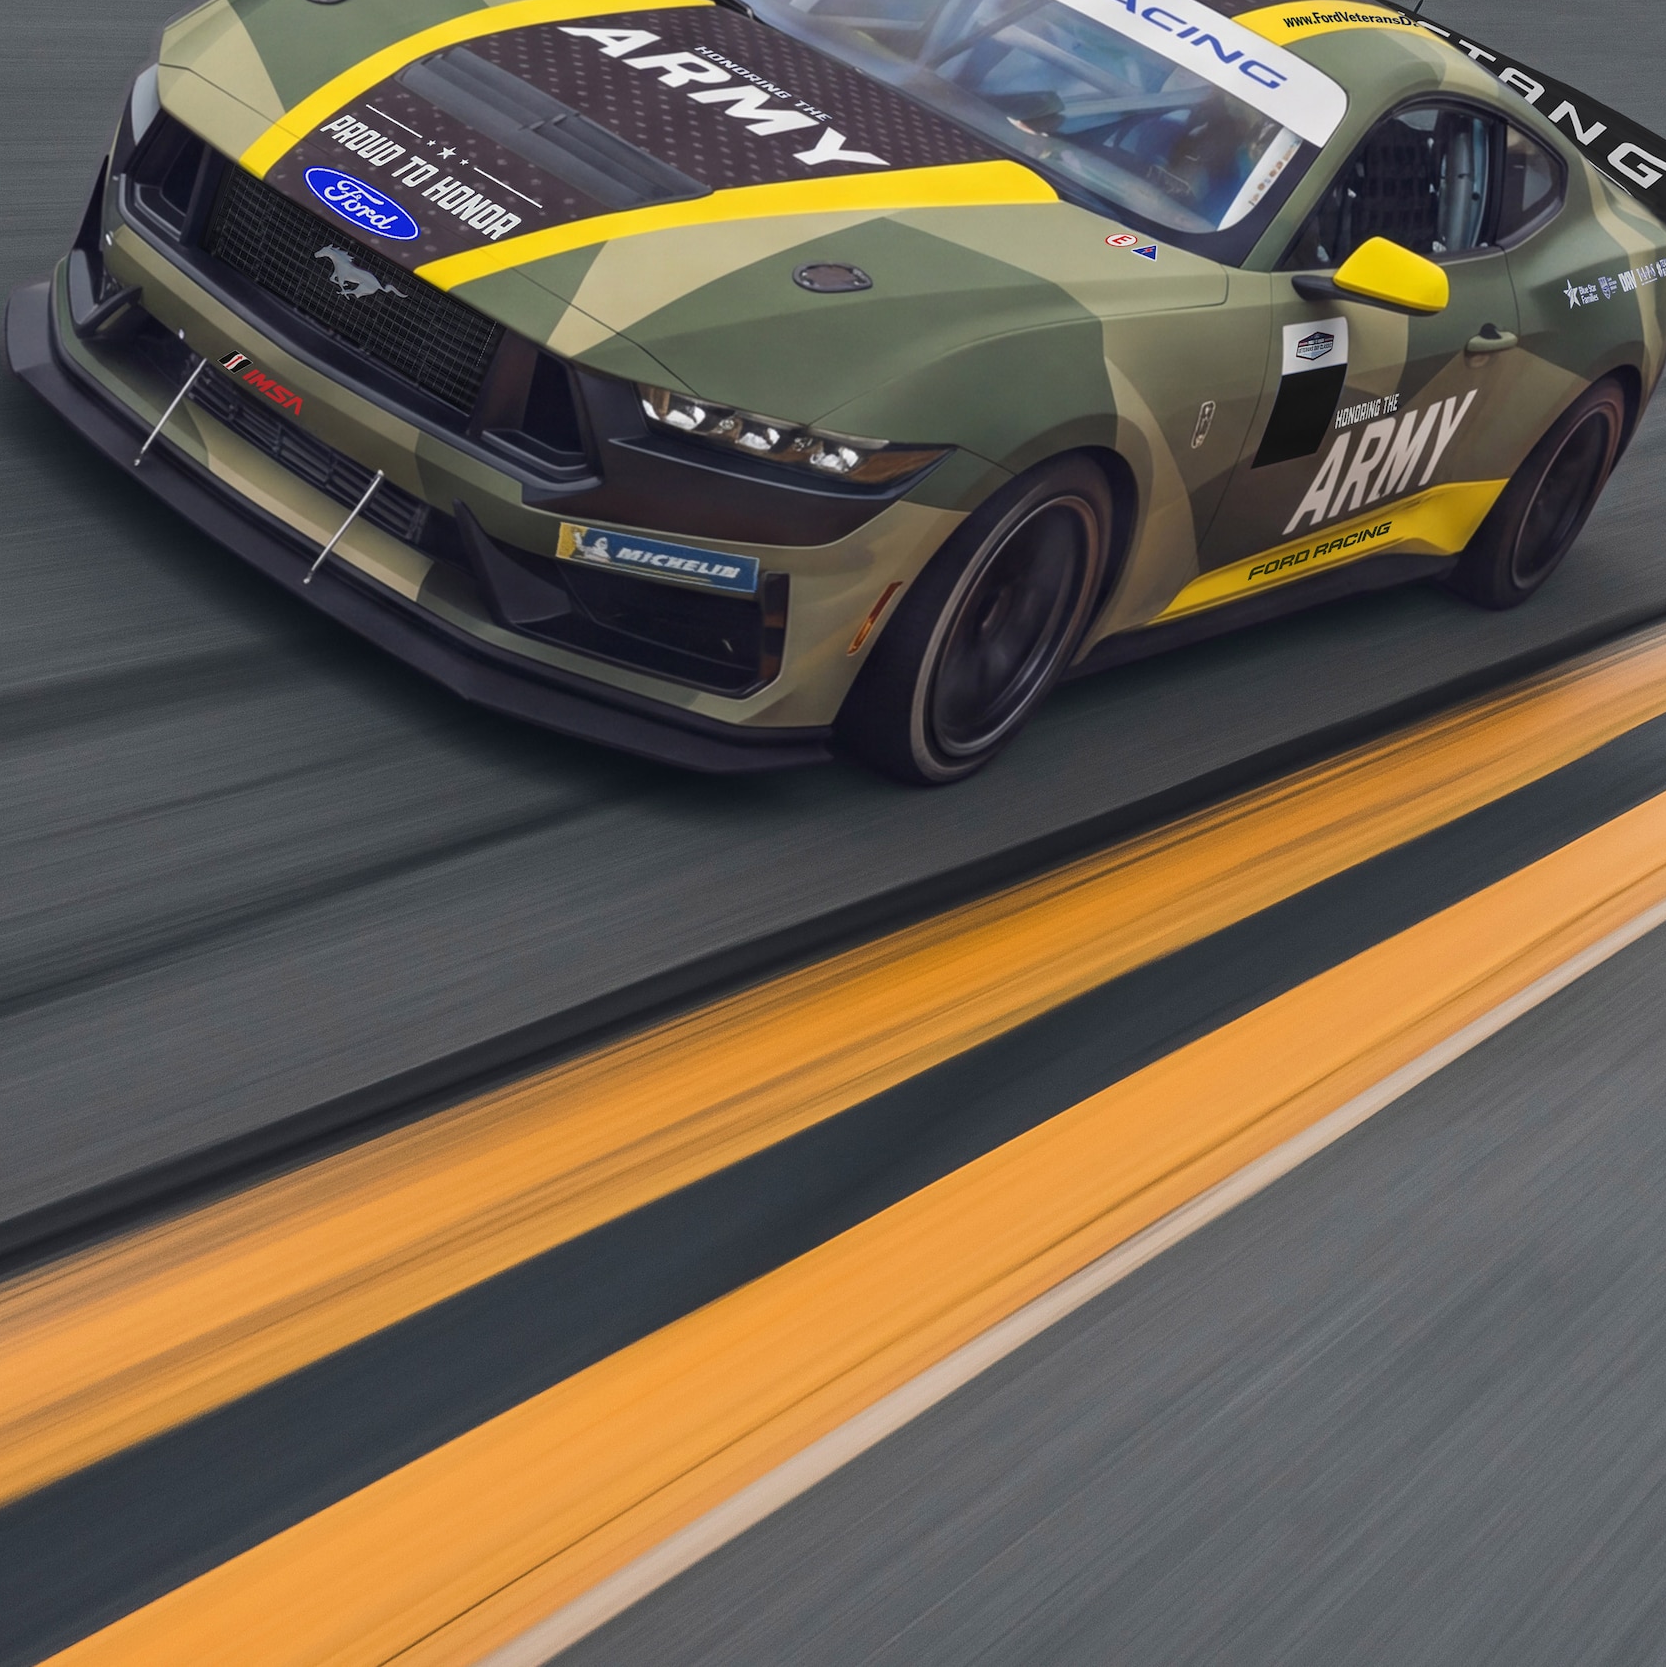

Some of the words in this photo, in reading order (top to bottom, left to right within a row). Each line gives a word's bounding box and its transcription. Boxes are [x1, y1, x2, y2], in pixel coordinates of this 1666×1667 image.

[557, 26, 892, 166] ARMY
[694, 45, 792, 100] HONORING
[794, 99, 833, 123] THE
[319, 114, 407, 167] PROUD
[391, 155, 440, 188] TO
[421, 176, 523, 241] HONOR
[323, 180, 399, 231] Ford
[1111, 235, 1133, 245] E
[241, 368, 304, 417] IMSA
[1334, 398, 1382, 430] HONORING
[1382, 393, 1401, 415] THE
[1282, 388, 1478, 536] ARMY
[615, 547, 741, 579] MICHELIN
[1247, 549, 1311, 582] FORD
[1313, 521, 1393, 560] RACING
